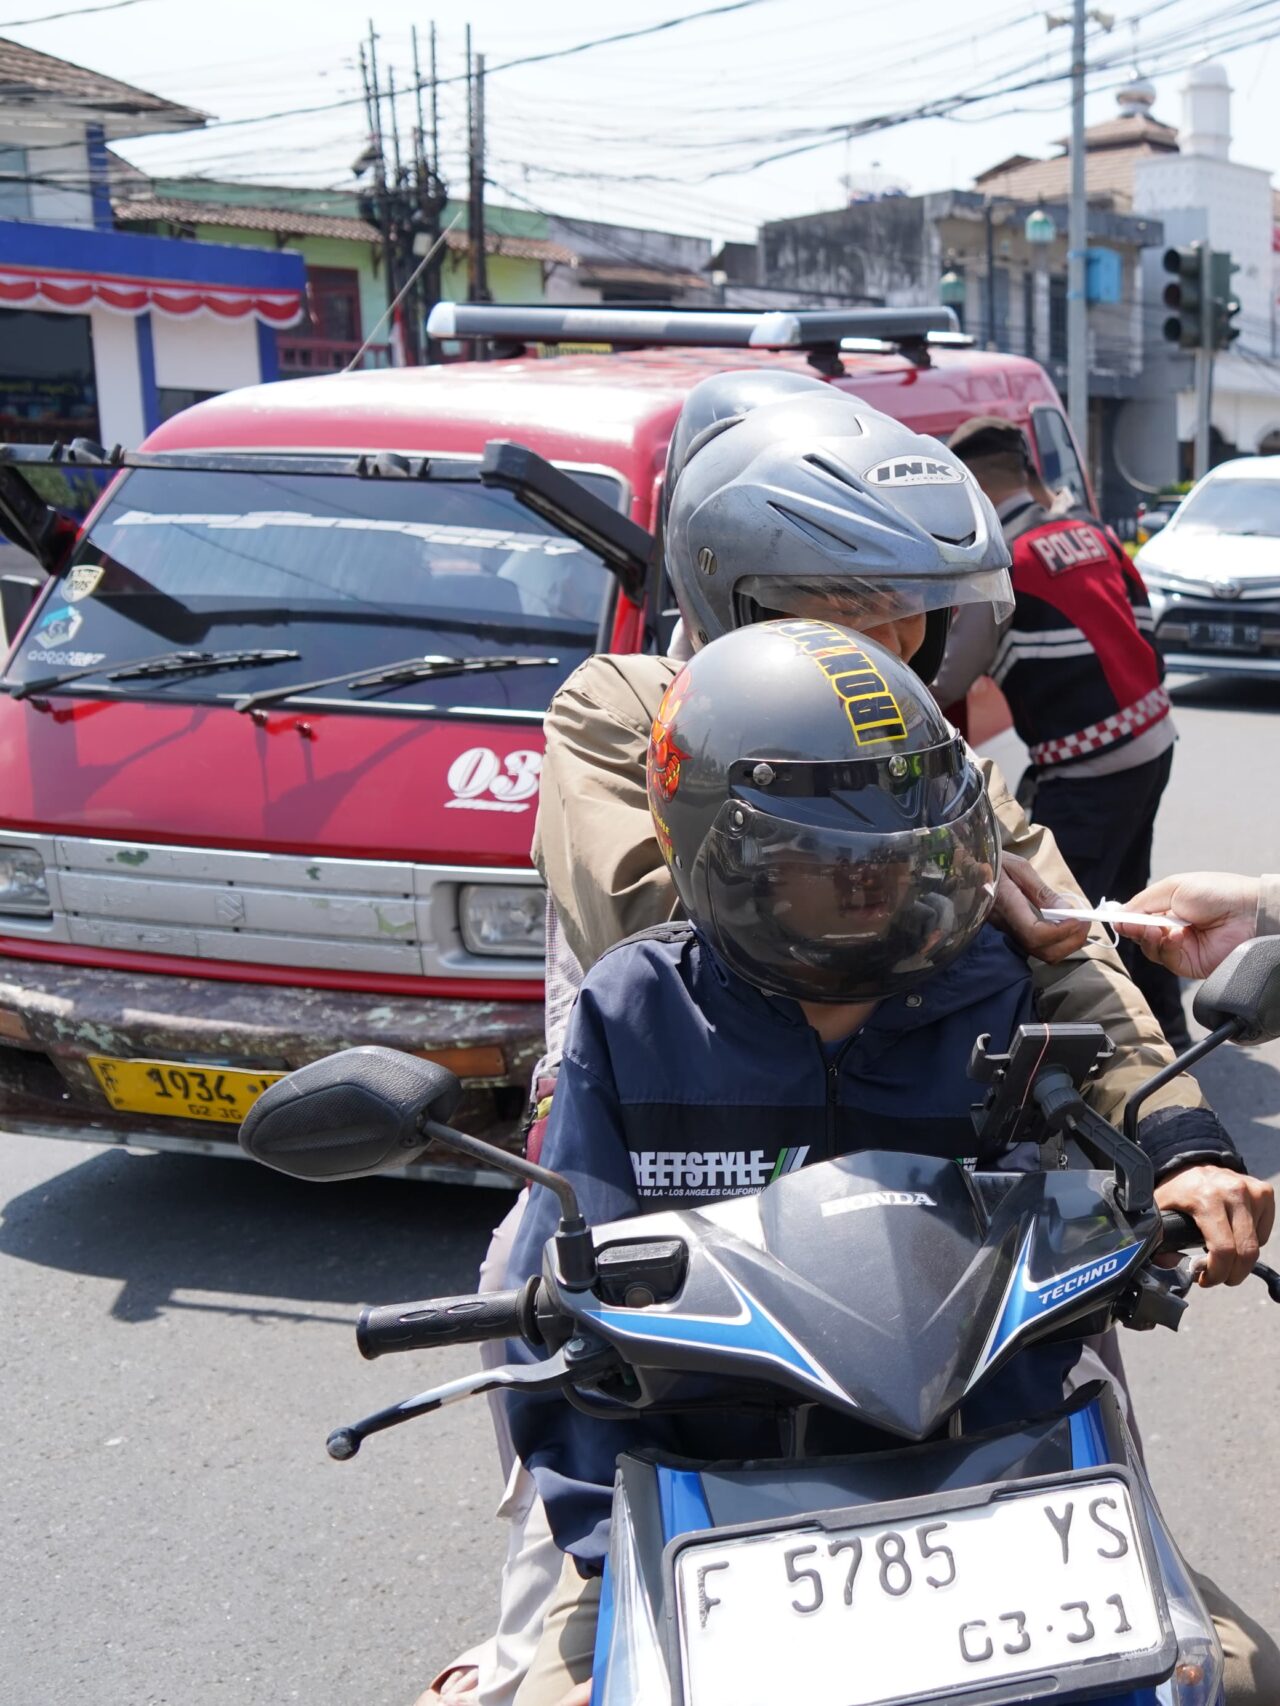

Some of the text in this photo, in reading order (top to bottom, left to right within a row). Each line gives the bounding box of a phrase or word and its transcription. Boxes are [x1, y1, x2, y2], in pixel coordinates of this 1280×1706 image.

[877, 462, 953, 482] INK
[1032, 526, 1108, 573] POLISI
[447, 747, 544, 802] 03
[146, 1068, 237, 1105] 1934
[669, 1188, 684, 1197] LOS
[685, 1187, 721, 1197] ANGELES
[820, 1190, 938, 1218] HONDA
[1038, 1258, 1118, 1305] TECHNO
[696, 1560, 731, 1629] F
[784, 1520, 957, 1614] 5785
[1043, 1496, 1129, 1565] YS
